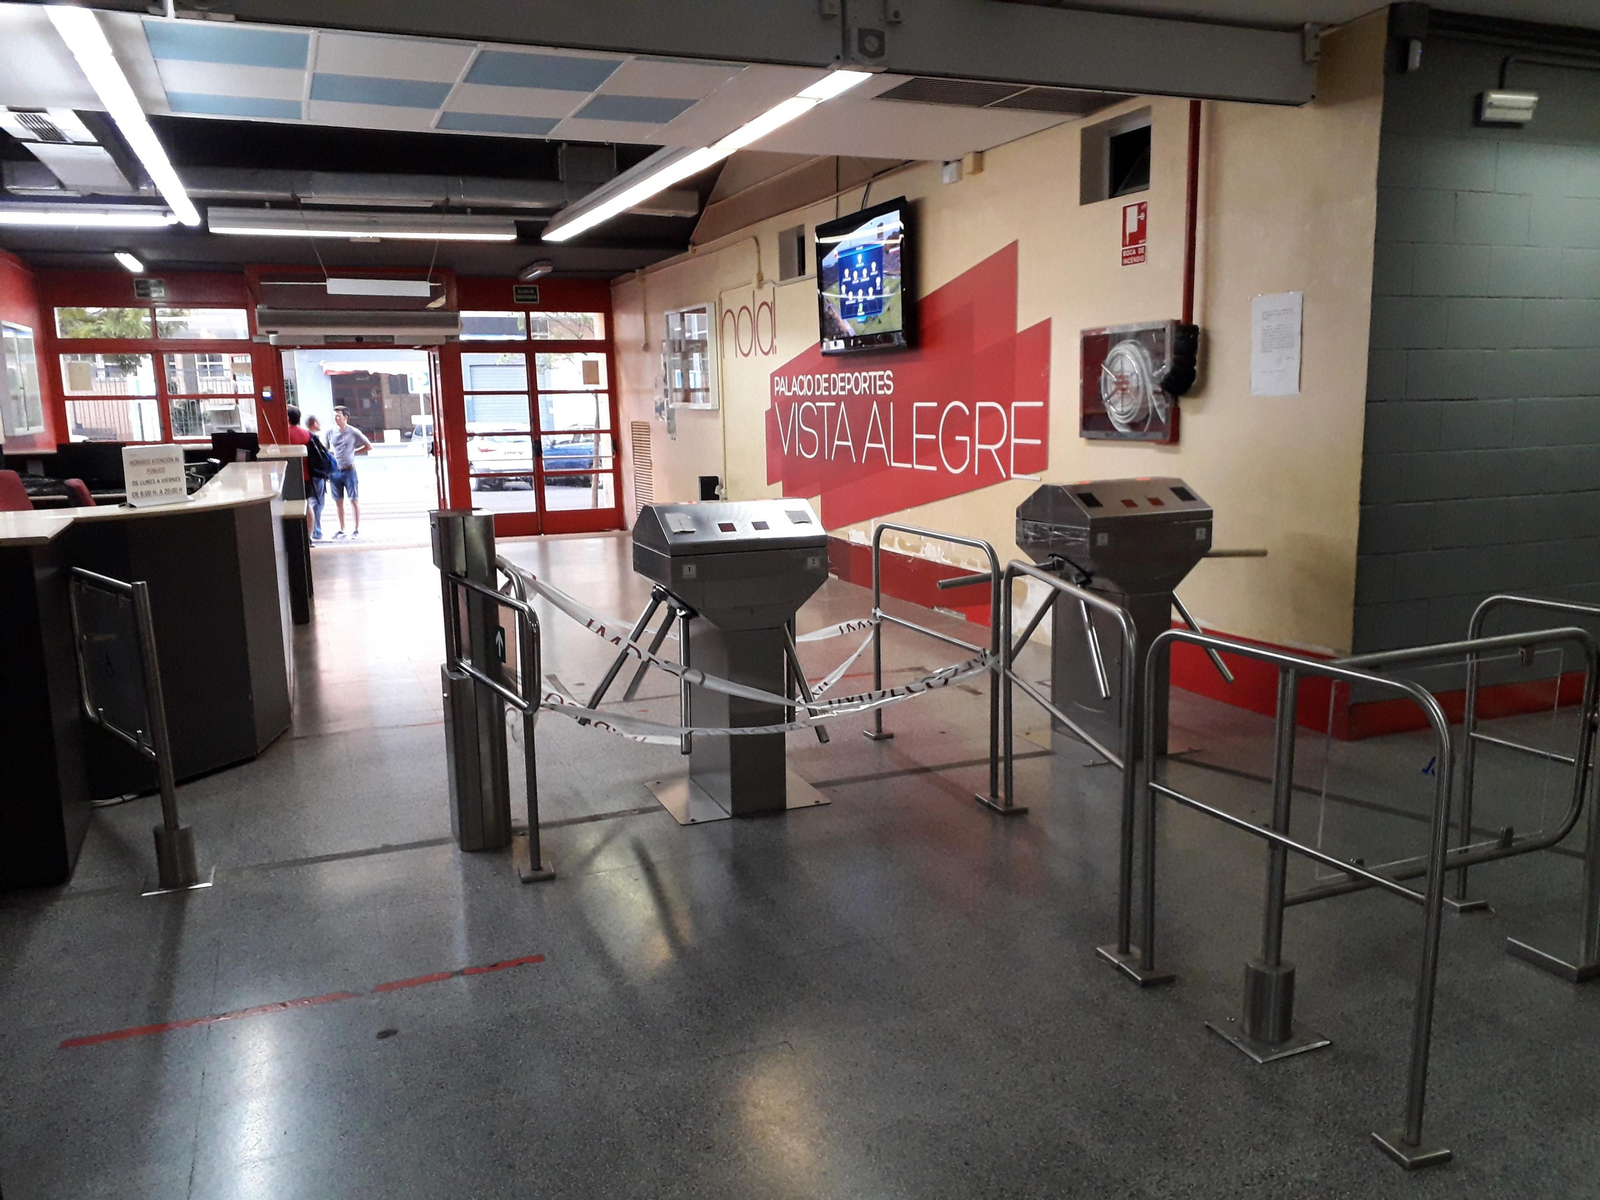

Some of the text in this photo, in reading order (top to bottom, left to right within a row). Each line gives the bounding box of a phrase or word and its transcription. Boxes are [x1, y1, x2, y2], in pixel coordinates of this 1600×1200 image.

[1138, 246, 1145, 254] DE
[774, 370, 894, 396] PALACIO DE DEPORTES
[774, 400, 1044, 481] VISTA ALEGRE
[132, 491, 139, 499] DE
